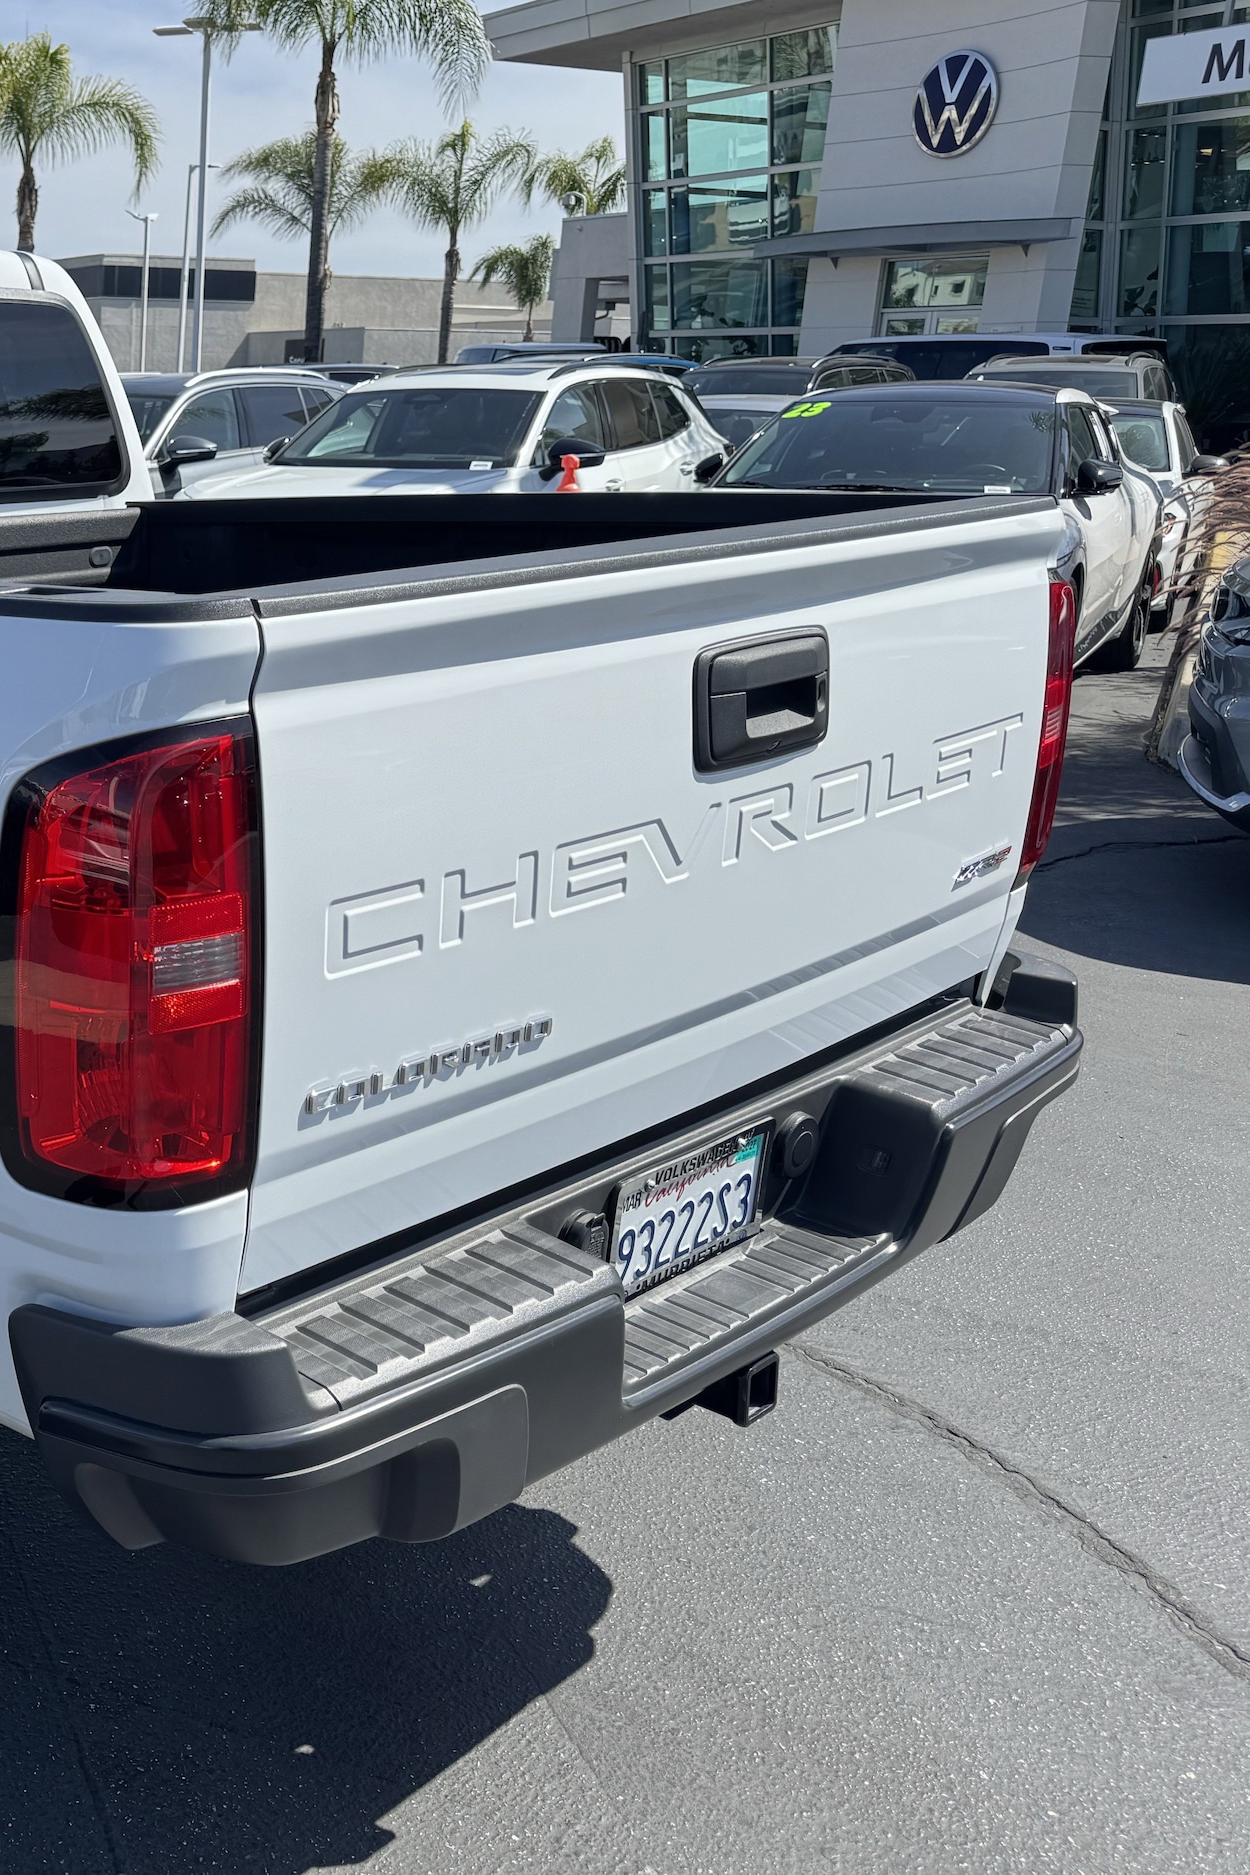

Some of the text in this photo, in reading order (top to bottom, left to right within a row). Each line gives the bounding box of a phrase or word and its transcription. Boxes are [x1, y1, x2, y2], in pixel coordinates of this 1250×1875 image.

[1201, 38, 1250, 84] M
[781, 401, 832, 418] 23
[324, 712, 1024, 980] CHEVROLET
[304, 1016, 552, 1115] COLORADO
[655, 1137, 738, 1185] VOLKSWAGEN
[618, 1173, 752, 1281] 93222S3
